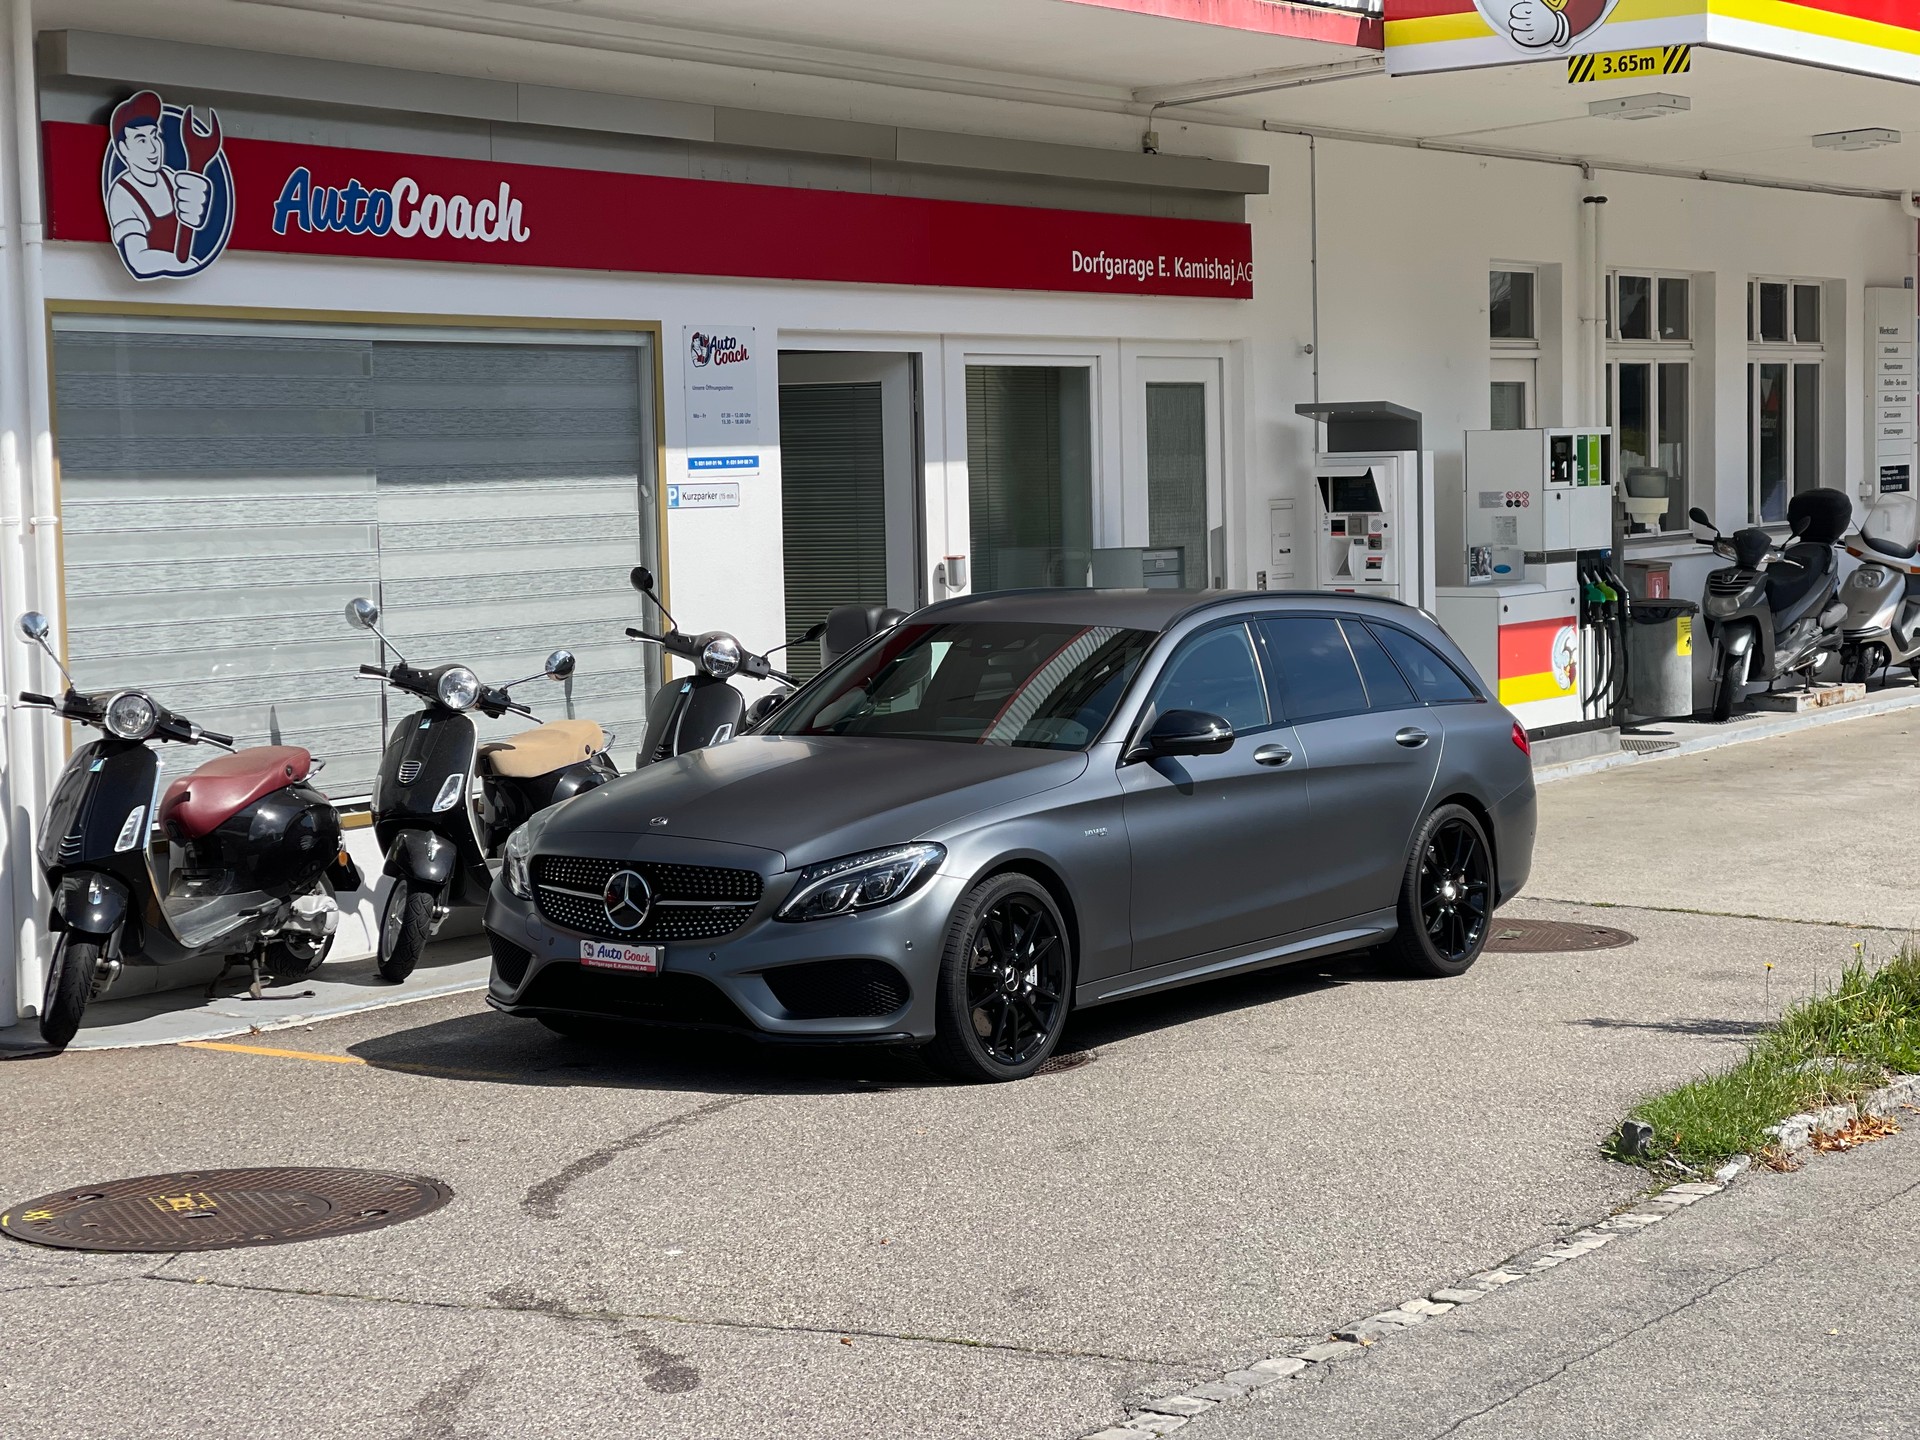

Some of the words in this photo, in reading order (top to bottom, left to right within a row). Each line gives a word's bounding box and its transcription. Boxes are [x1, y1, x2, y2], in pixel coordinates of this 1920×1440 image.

[1602, 55, 1655, 74] 3.65m
[1072, 250, 1154, 281] Dorfgarage
[1158, 255, 1170, 277] E.
[1174, 256, 1235, 286] Kamishaj
[709, 335, 737, 354] Auto
[713, 344, 749, 366] Coach
[1561, 460, 1568, 478] 1
[682, 491, 718, 502] Kurzparker
[597, 945, 622, 960] Auto
[623, 949, 651, 963] Coach
[959, 932, 973, 994] ontinental
